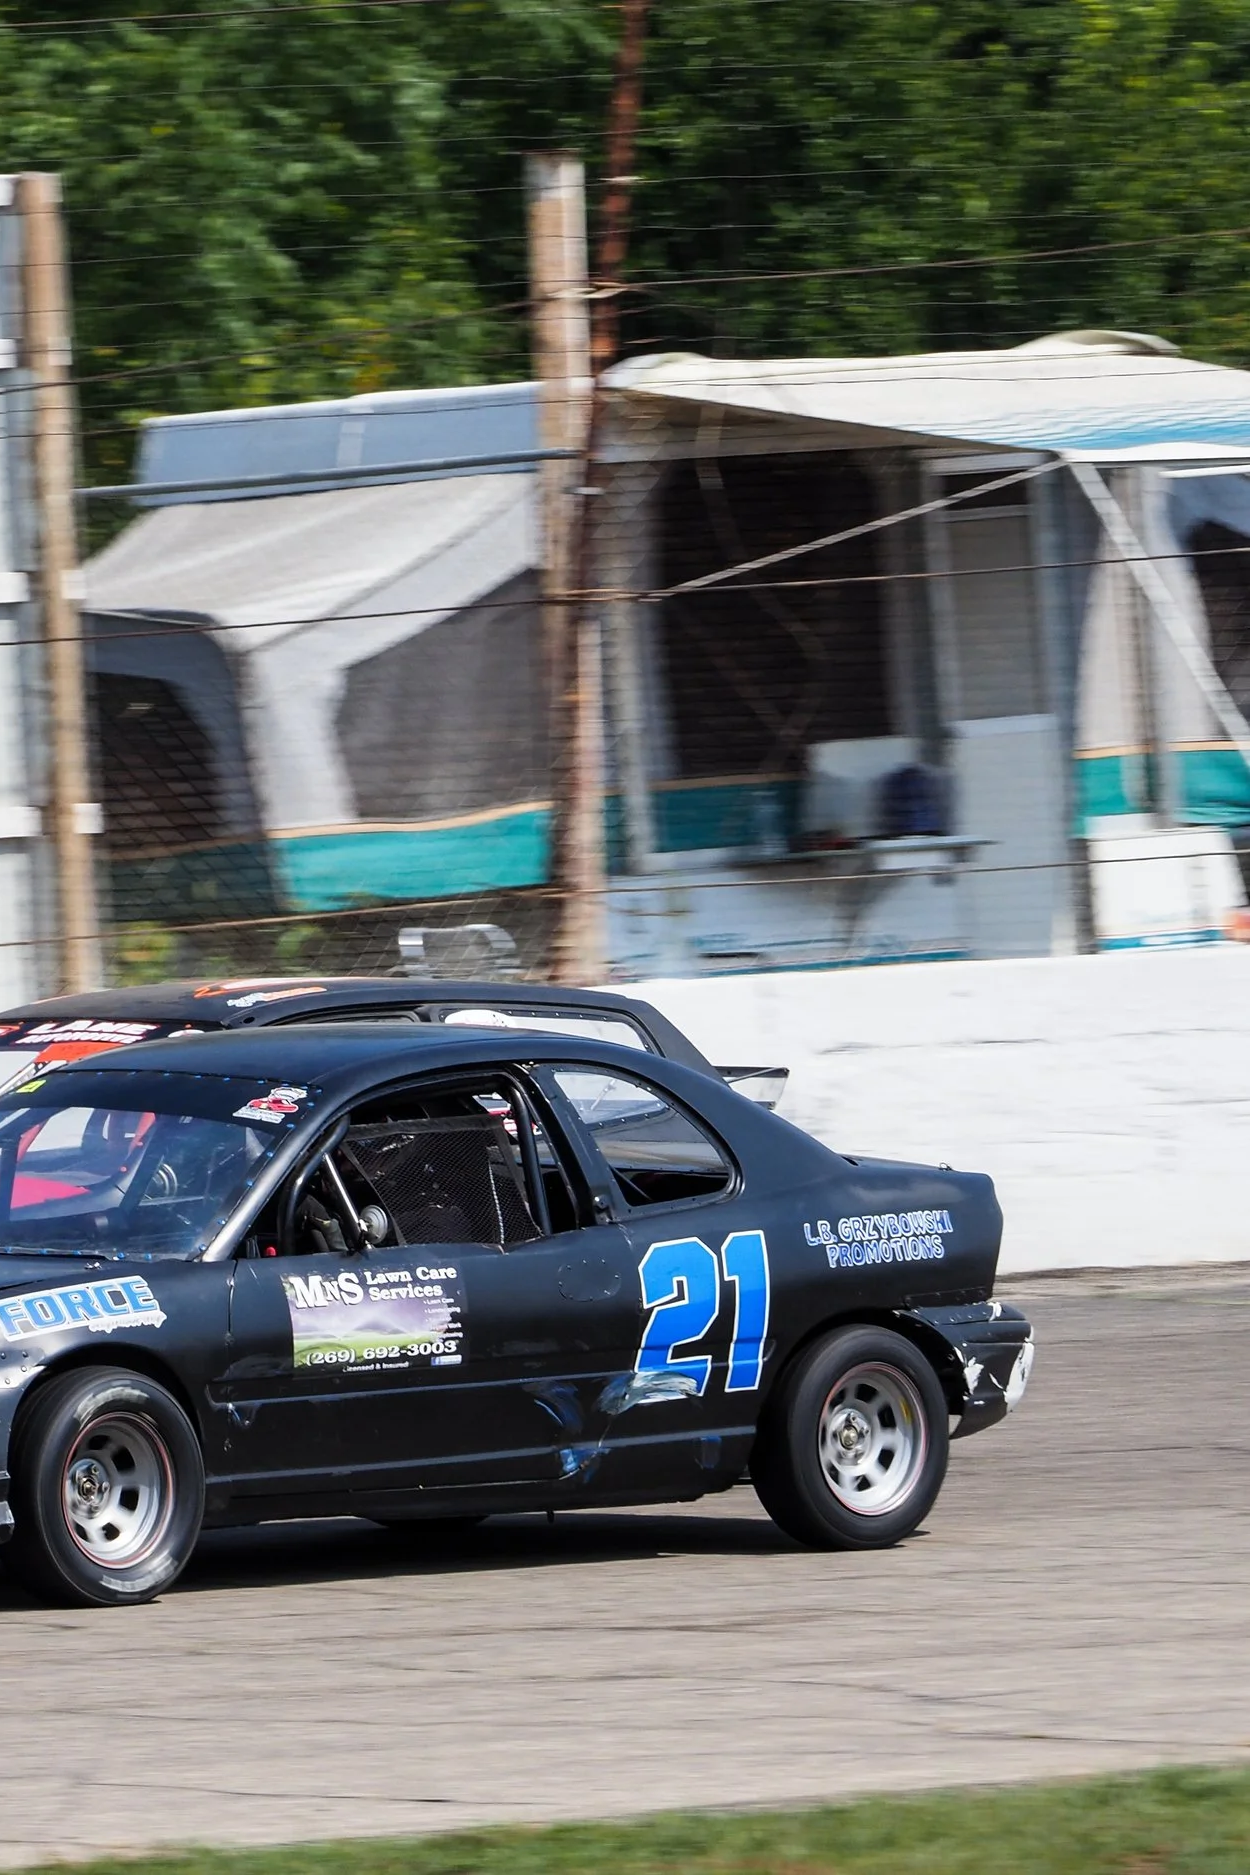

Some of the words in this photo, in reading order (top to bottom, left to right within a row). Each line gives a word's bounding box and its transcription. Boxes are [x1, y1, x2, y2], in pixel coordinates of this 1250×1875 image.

[25, 1020, 160, 1036] LANE
[838, 1210, 954, 1243] GRZYBOWSKI
[826, 1235, 945, 1268] PROMOTIONS
[365, 1270, 414, 1286] Lawn
[416, 1266, 457, 1281] Care
[369, 1284, 443, 1301] Services
[635, 1229, 770, 1403] 21
[306, 1349, 356, 1367] (269)
[363, 1340, 457, 1361] 692-3003
